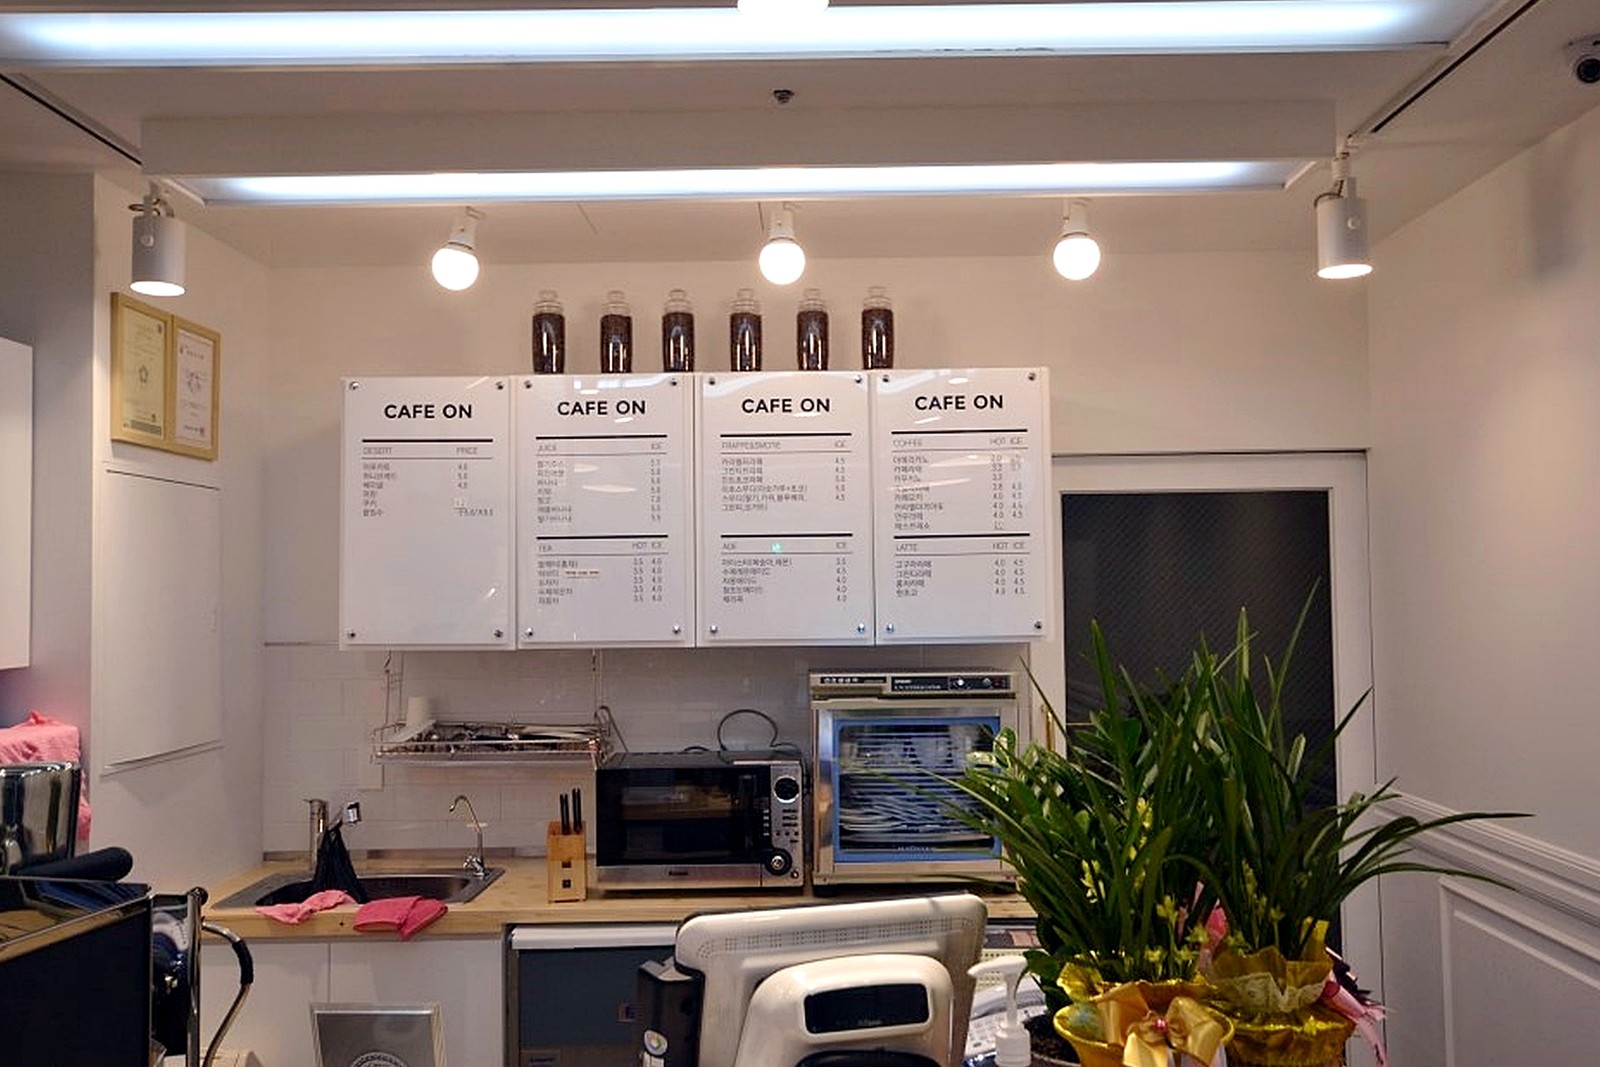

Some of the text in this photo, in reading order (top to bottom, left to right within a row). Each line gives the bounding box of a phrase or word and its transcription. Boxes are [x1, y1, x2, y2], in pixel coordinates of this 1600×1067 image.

[557, 400, 646, 416] CAFE ON
[741, 398, 831, 413] CAFE ON
[915, 395, 1003, 410] CAFE ON
[384, 404, 472, 419] CAFE ON
[896, 544, 917, 552] LATTE
